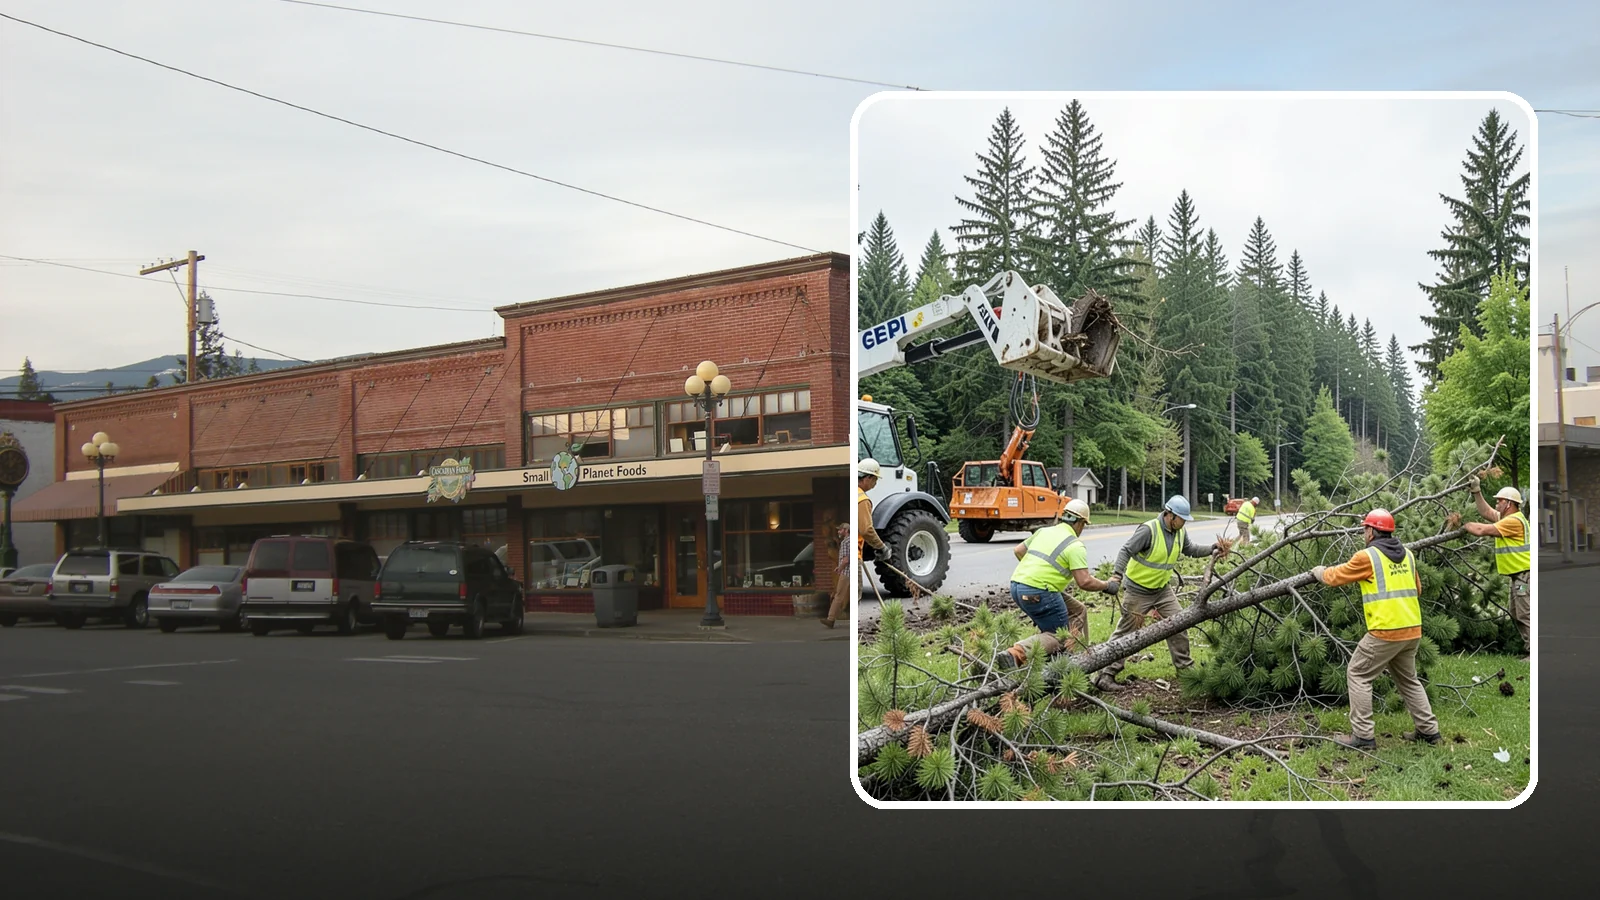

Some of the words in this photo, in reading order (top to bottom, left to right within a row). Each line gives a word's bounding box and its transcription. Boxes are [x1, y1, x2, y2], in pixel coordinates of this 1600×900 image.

[862, 316, 908, 350] GEPI
[523, 470, 549, 483] Small
[583, 467, 614, 479] Planet
[617, 464, 647, 477] Foods
